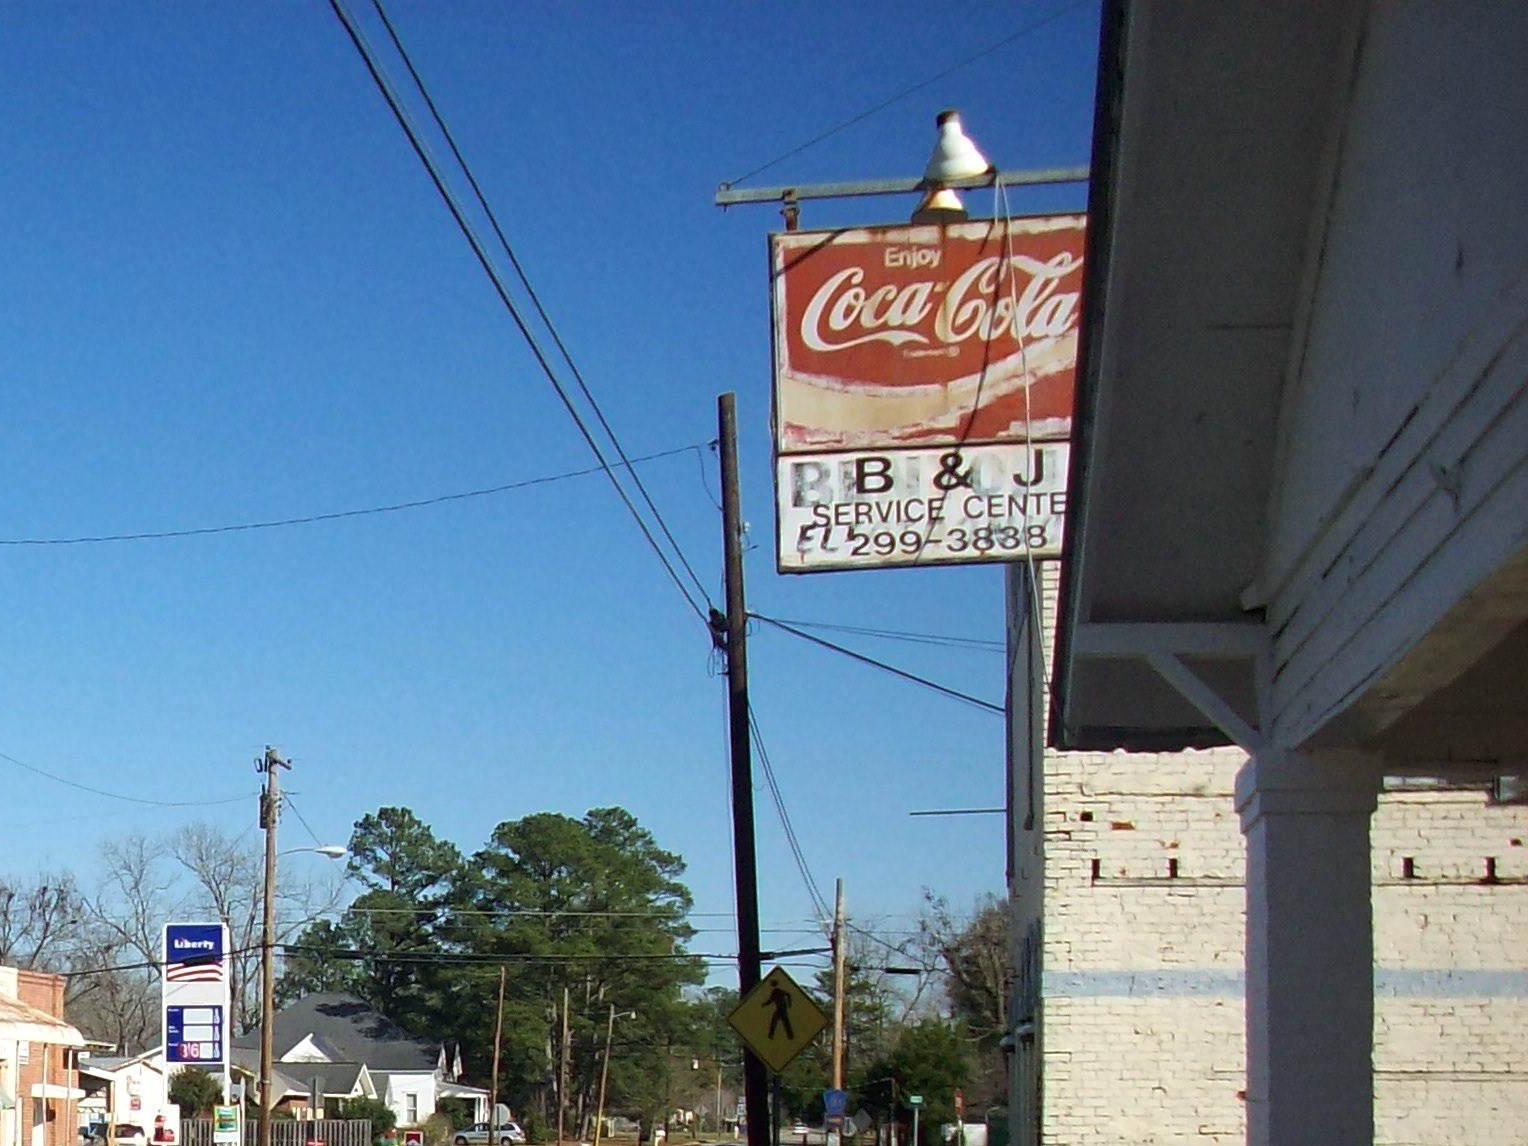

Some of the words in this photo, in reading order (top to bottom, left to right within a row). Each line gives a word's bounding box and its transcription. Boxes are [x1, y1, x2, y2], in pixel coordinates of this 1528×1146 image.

[884, 246, 942, 268] Enjoy
[800, 251, 1084, 351] Coca-Cola
[856, 456, 894, 494] B
[933, 452, 972, 490] &
[1013, 448, 1045, 487] J
[812, 497, 945, 528] SERVICE
[850, 524, 1048, 556] 299-3838
[173, 938, 216, 950] Liberty
